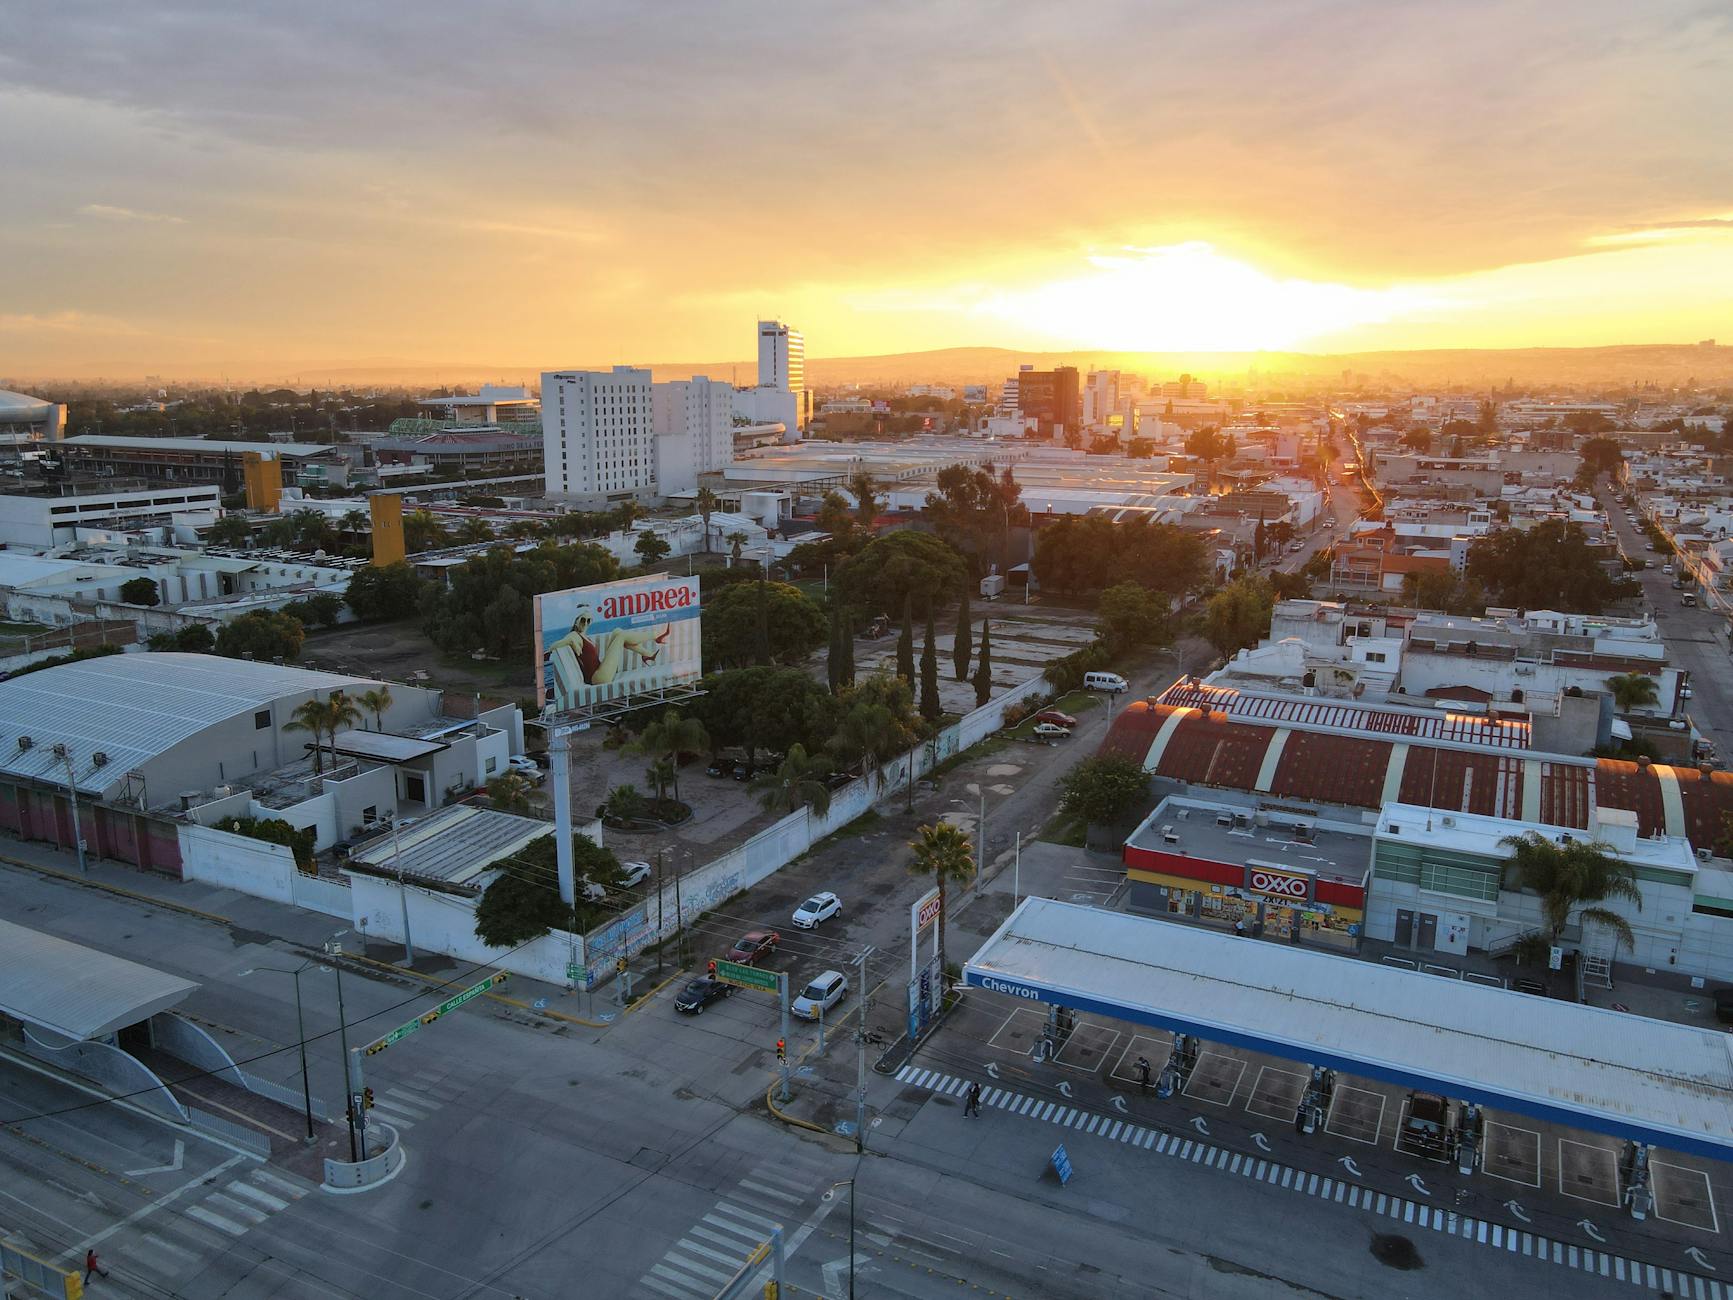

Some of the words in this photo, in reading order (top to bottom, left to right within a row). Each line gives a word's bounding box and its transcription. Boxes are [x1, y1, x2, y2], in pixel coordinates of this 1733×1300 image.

[1252, 873, 1306, 896] OXXO
[919, 899, 940, 924] OXXO
[981, 977, 1039, 1000] Chevron
[446, 996, 463, 1010] CALLE
